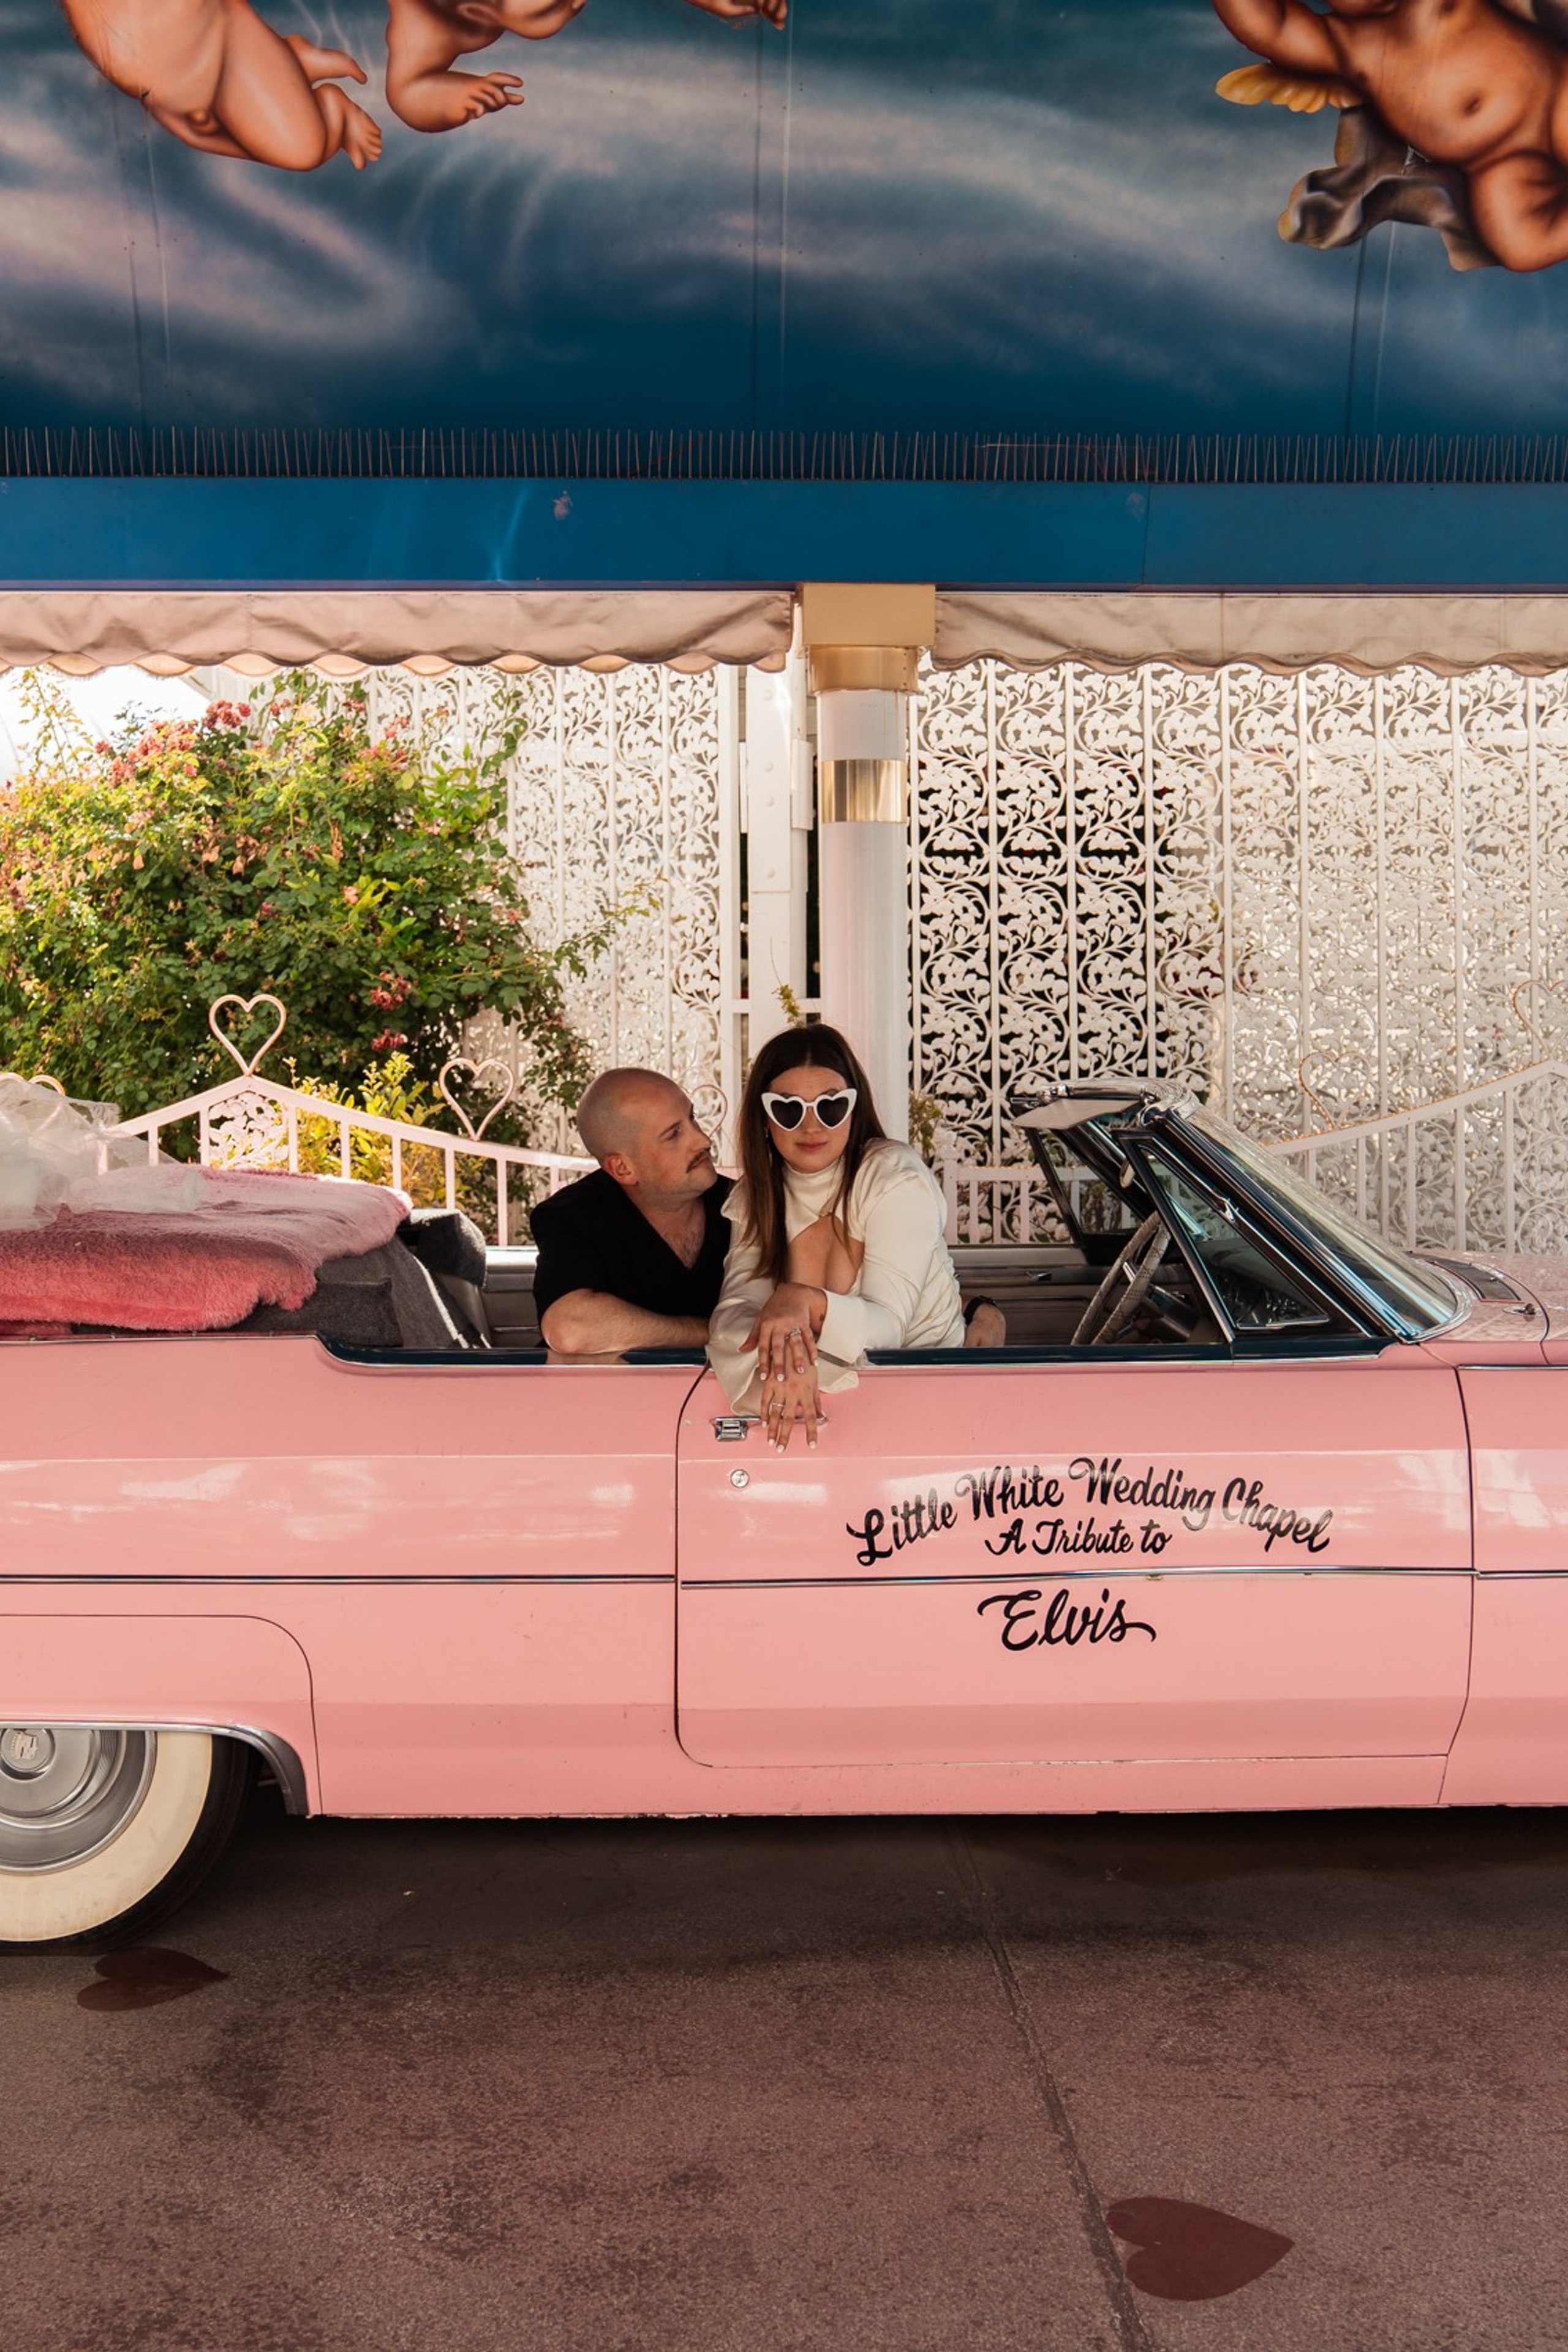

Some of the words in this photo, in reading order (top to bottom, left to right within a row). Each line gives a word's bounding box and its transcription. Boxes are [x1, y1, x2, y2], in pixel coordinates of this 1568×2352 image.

[846, 1487, 958, 1566] Little
[955, 1466, 1065, 1520] White
[1068, 1457, 1216, 1531] Wedding
[1222, 1477, 1333, 1553] Chapel
[984, 1518, 1027, 1555] A
[1031, 1517, 1134, 1555] Tribute
[1140, 1519, 1173, 1554] to
[978, 1588, 1156, 1651] Elvis
